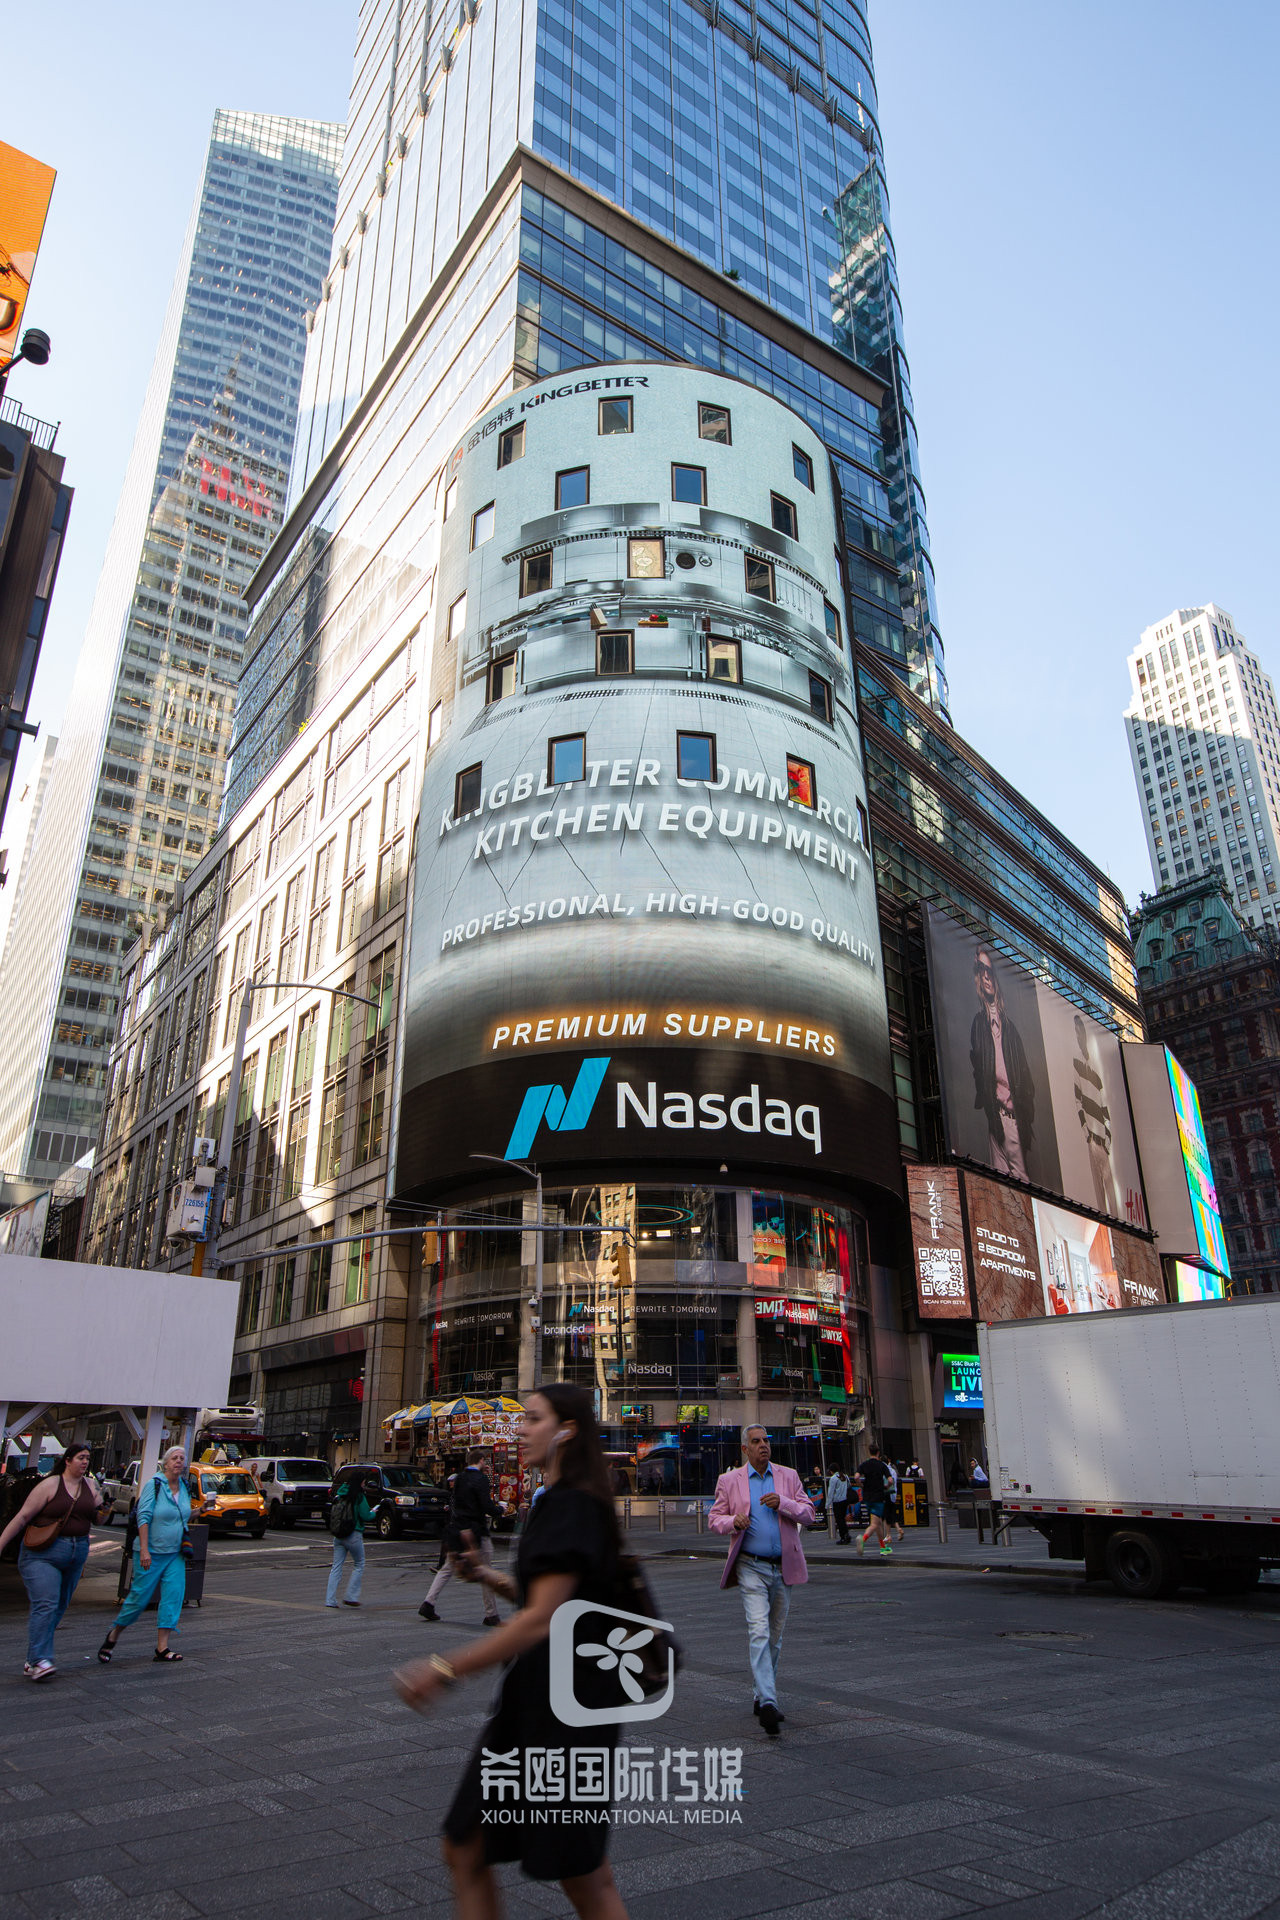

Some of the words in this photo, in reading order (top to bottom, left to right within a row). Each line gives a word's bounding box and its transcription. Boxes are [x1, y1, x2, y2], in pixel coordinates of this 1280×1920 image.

[467, 407, 514, 454] 金佰特
[676, 763, 871, 860] OMMRCIA
[473, 803, 644, 860] KITCHEN
[658, 803, 859, 881] EQUIPMENT
[441, 893, 635, 950] PROFESSIONAL,
[645, 892, 804, 931] HIGH-GOOD
[811, 918, 875, 967] QUALITY
[492, 1013, 647, 1049] PREMIUM
[663, 1013, 836, 1056] SUPPLIERS
[617, 1081, 822, 1155] Nasdaq
[926, 1181, 939, 1239] FRANK
[1125, 1187, 1145, 1227] H&M
[976, 1226, 1007, 1244] STUDIO
[1007, 1236, 1020, 1248] TO
[978, 1241, 985, 1252] 2
[986, 1243, 1026, 1264] BEDROOM
[980, 1257, 1036, 1281] APARTMENTS
[1123, 1278, 1159, 1302] FRANK
[477, 1311, 513, 1324] TOMORROW
[584, 1304, 615, 1315] Nasdaq
[630, 1305, 667, 1313] REWRITE
[671, 1305, 718, 1314] TOMORROW
[785, 1309, 809, 1320] Nasdaq
[628, 1362, 672, 1377] Nasdaq
